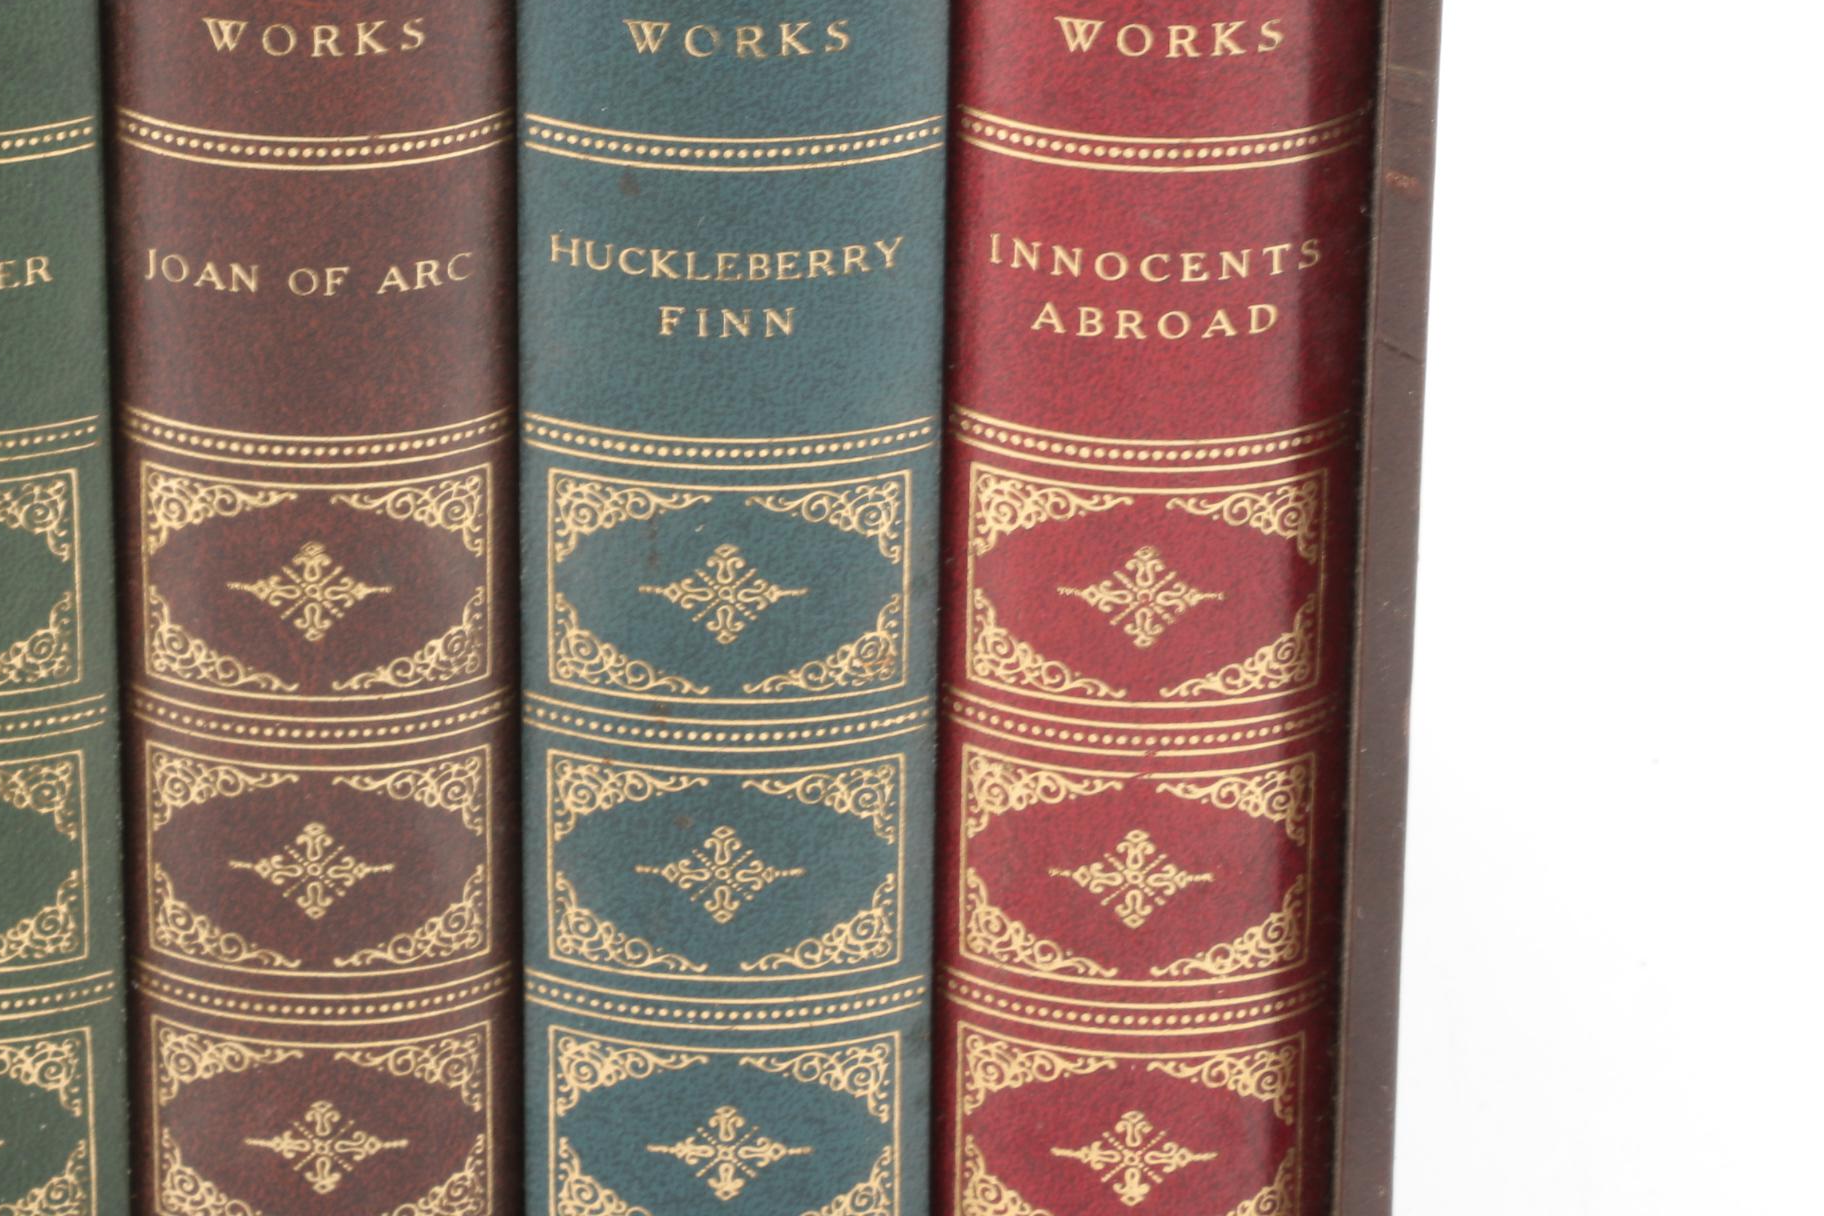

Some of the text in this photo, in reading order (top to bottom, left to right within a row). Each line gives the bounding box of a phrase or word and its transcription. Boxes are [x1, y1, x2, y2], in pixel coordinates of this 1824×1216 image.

[203, 18, 426, 57] WORKS
[624, 19, 851, 59] WORKS
[1055, 16, 1284, 57] WORKS
[146, 248, 473, 296] JOAN OF ARC
[550, 234, 904, 281] HUCKLEBERRY
[990, 233, 1322, 281] INNOCENTS
[658, 307, 797, 338] FINN
[1032, 301, 1278, 339] ABROAD
